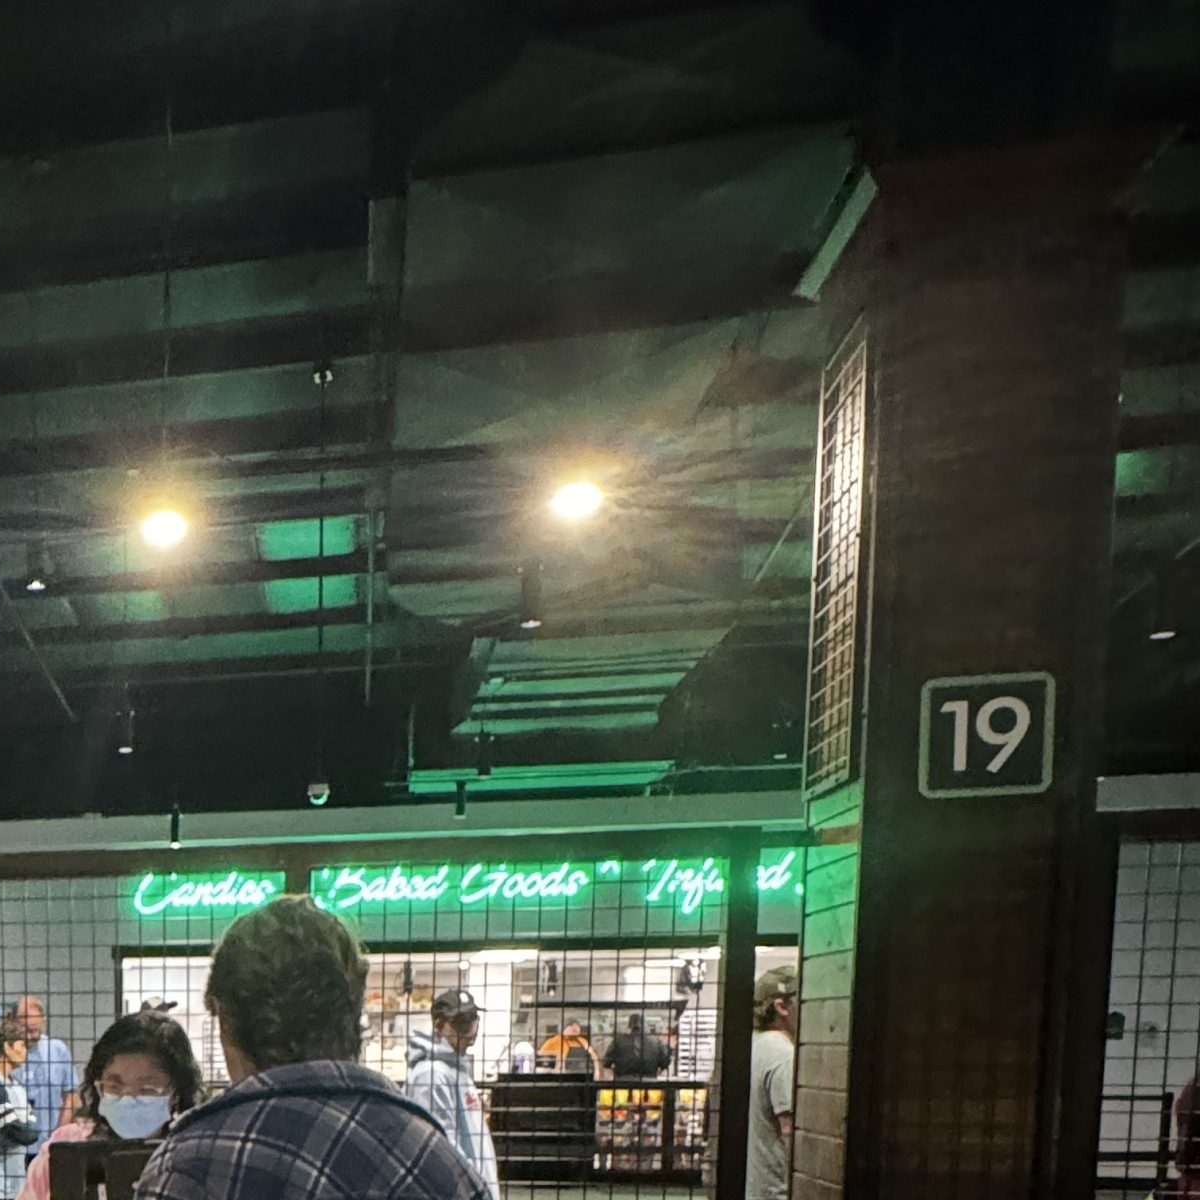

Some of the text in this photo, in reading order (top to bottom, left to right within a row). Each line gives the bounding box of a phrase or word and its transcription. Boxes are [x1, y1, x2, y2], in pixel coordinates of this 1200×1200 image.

[940, 696, 1030, 773] 19
[134, 871, 277, 915] Candies
[461, 862, 590, 903] Goods
